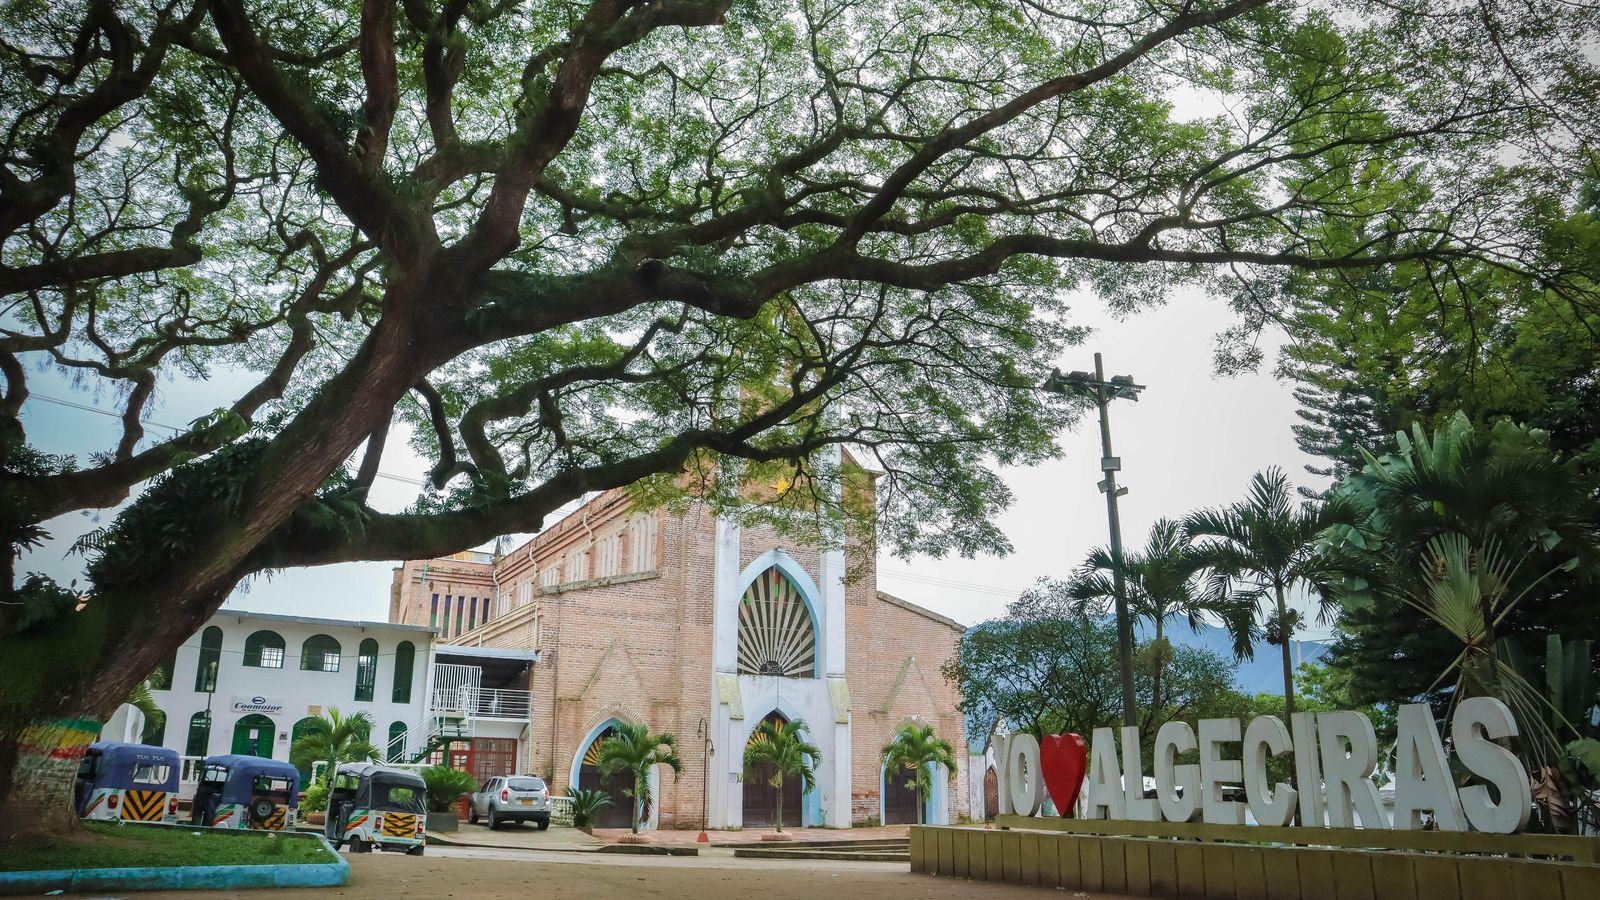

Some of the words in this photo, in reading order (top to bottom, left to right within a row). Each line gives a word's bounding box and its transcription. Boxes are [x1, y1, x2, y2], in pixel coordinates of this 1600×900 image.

[234, 702, 283, 711] Coomotor
[991, 734, 1042, 817] YO
[1087, 696, 1532, 835] ALGECIRAS
